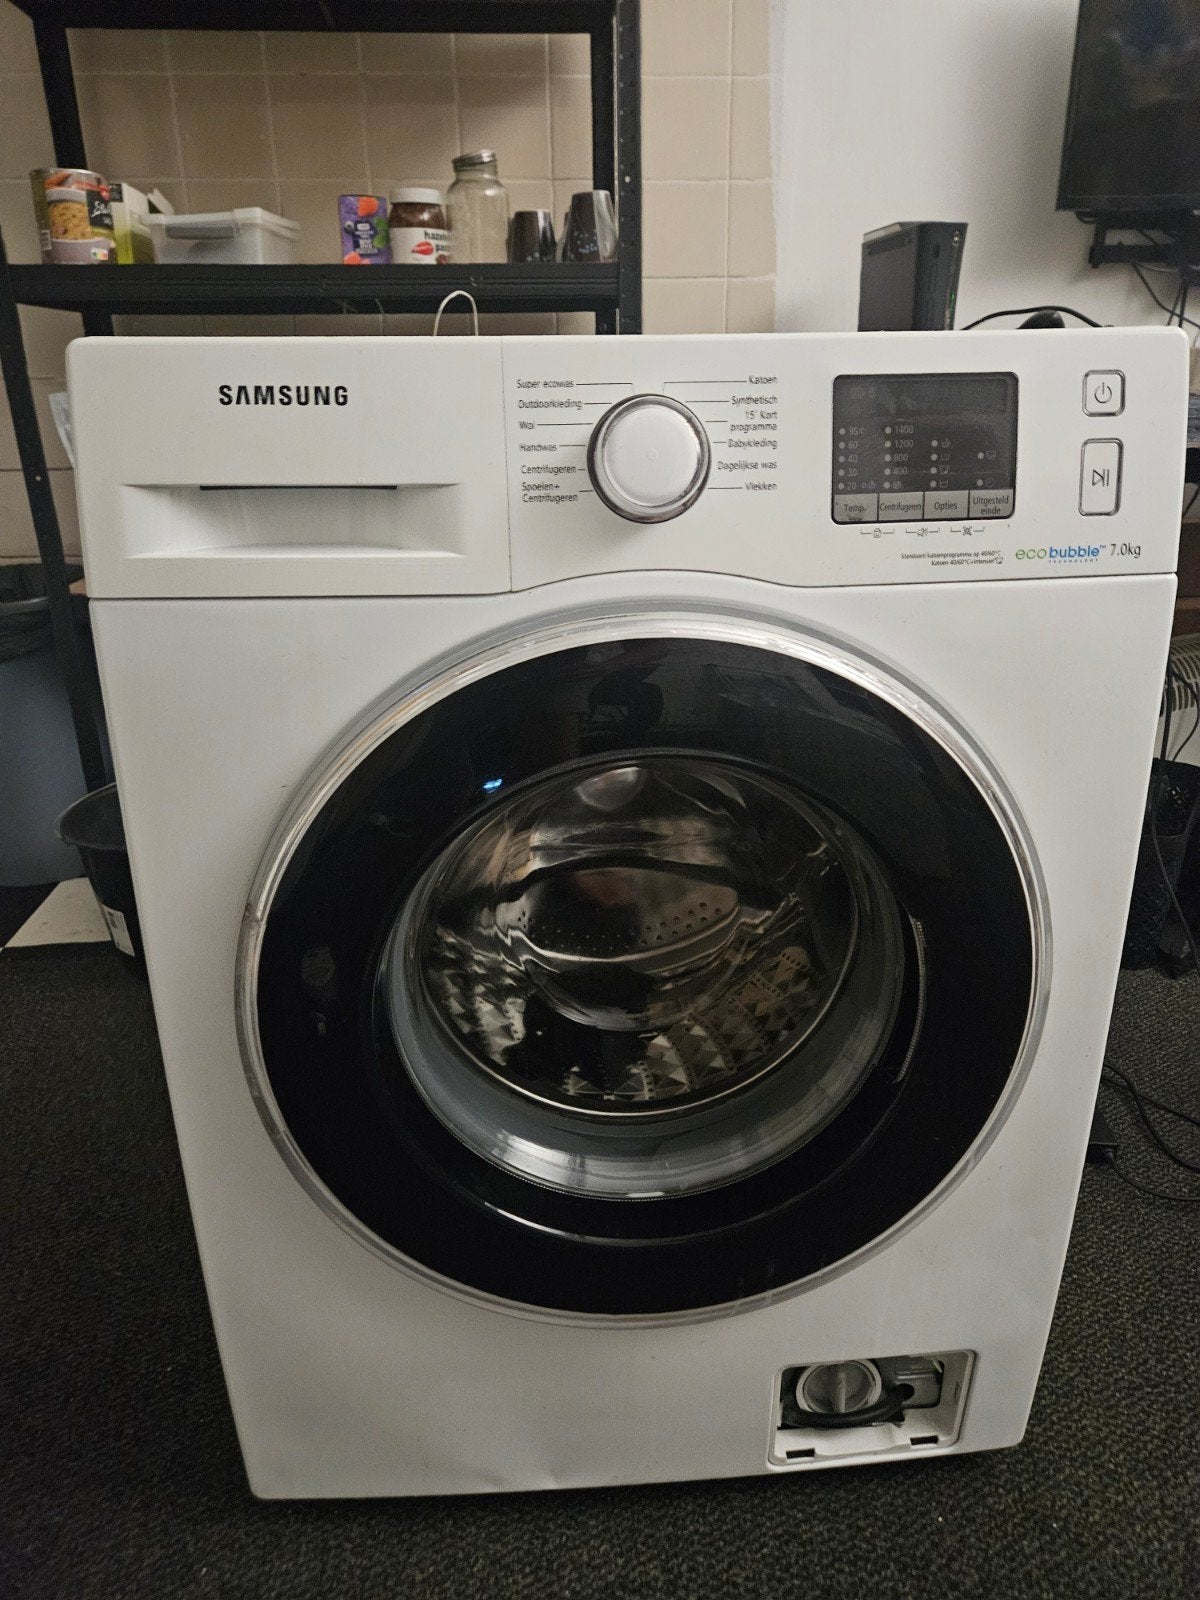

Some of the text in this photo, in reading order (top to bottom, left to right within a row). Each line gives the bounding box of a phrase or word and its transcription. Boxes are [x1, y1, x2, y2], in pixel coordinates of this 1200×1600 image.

[516, 379, 574, 389] Super ecowas
[748, 375, 778, 385] Katoen
[219, 385, 349, 406] SAMSUNG
[518, 399, 583, 411] Outdoorkleding
[731, 395, 778, 408] Synthetisch
[760, 410, 778, 420] Kort
[518, 420, 536, 430] Wol
[730, 423, 778, 434] programma
[894, 424, 914, 434] 1400
[519, 443, 557, 452] Handwas
[728, 438, 778, 450] Babykleding
[894, 439, 914, 449] 1200
[521, 464, 577, 475] Centrifugeren
[717, 460, 778, 472] Dagelijkse was
[521, 482, 560, 492] Spoelen+
[745, 481, 778, 491] Vlekken
[522, 493, 578, 504] Centrifugeren
[973, 495, 1009, 507] Uitgesteld
[880, 502, 922, 514] Centrifugeren
[934, 500, 958, 511] Opties
[980, 507, 1001, 516] einde
[1110, 543, 1141, 558] 7.0kg
